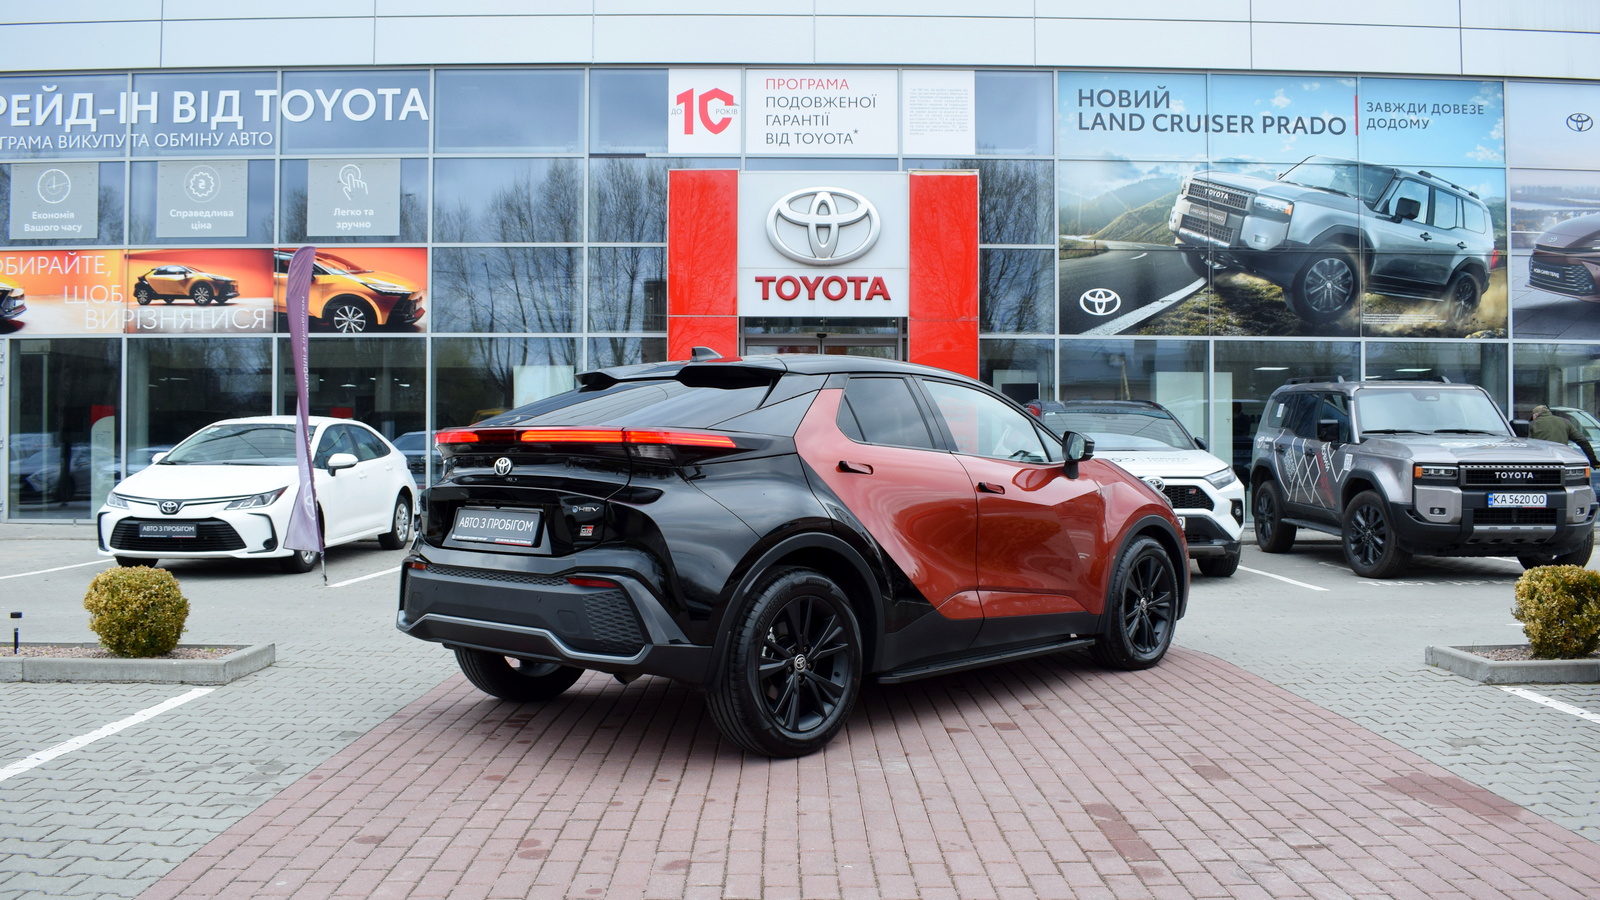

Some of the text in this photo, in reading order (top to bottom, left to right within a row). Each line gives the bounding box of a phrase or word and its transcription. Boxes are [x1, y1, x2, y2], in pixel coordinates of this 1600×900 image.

[765, 78, 850, 90] ПРОГРАМА
[765, 93, 877, 110] ПОДОВЖЕНОЇ
[1078, 85, 1170, 109] НОВИЙ
[172, 90, 244, 130] ВІД
[255, 87, 429, 122] TOYOTA
[1366, 101, 1485, 116] ЗАВЖДИ ДОВЕЗЕ
[765, 111, 831, 126] ГАРАНТІЇ
[1078, 112, 1347, 136] LAND CRUISER PRADO
[1366, 117, 1430, 131] ДОДОМУ
[58, 133, 127, 149] ВИКУПУ
[130, 133, 150, 147] ТА
[154, 131, 224, 147] ОБМІНУ
[227, 131, 273, 146] АВТО
[765, 132, 790, 147] ВІД
[1204, 188, 1229, 200] TOYOTA
[32, 210, 75, 220] Економія
[169, 208, 234, 219] Справедлива
[333, 207, 362, 217] Легко
[24, 223, 83, 233] Вашого часу
[191, 220, 212, 231] ціна
[335, 221, 372, 231] зручно
[0, 251, 111, 277] БИРАЙТЕ,
[64, 284, 123, 306] ЩОБ
[754, 275, 892, 301] TOYOTA
[85, 308, 266, 330] ВИРІЗНЯТИСЯ
[1494, 471, 1534, 479] TOYOTA
[1493, 494, 1507, 504] KA
[1509, 494, 1531, 504] 5620
[459, 516, 480, 528] АВТО
[486, 517, 534, 532] ПРОБІГОМ
